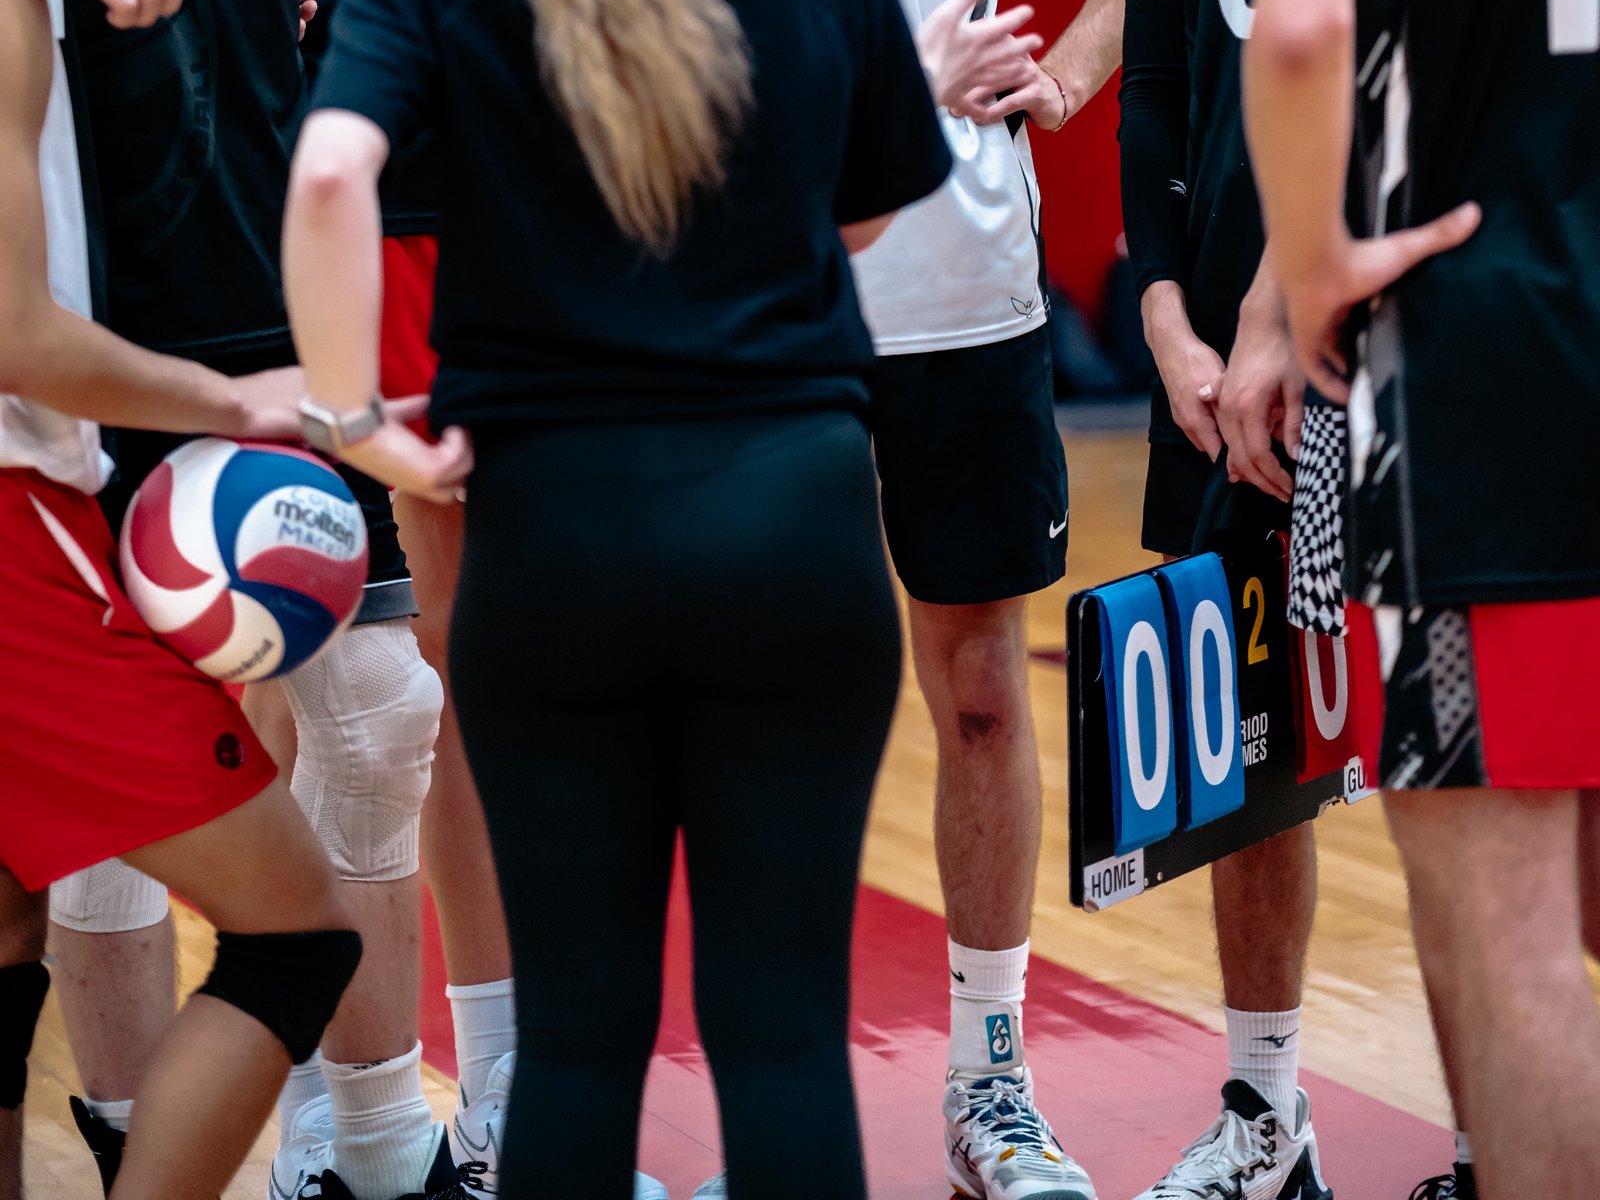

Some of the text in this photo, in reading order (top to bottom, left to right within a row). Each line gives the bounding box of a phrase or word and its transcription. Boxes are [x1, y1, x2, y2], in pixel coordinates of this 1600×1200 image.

[1243, 576, 1269, 665] 2
[1348, 765, 1366, 793] GU
[1091, 858, 1136, 899] HOME
